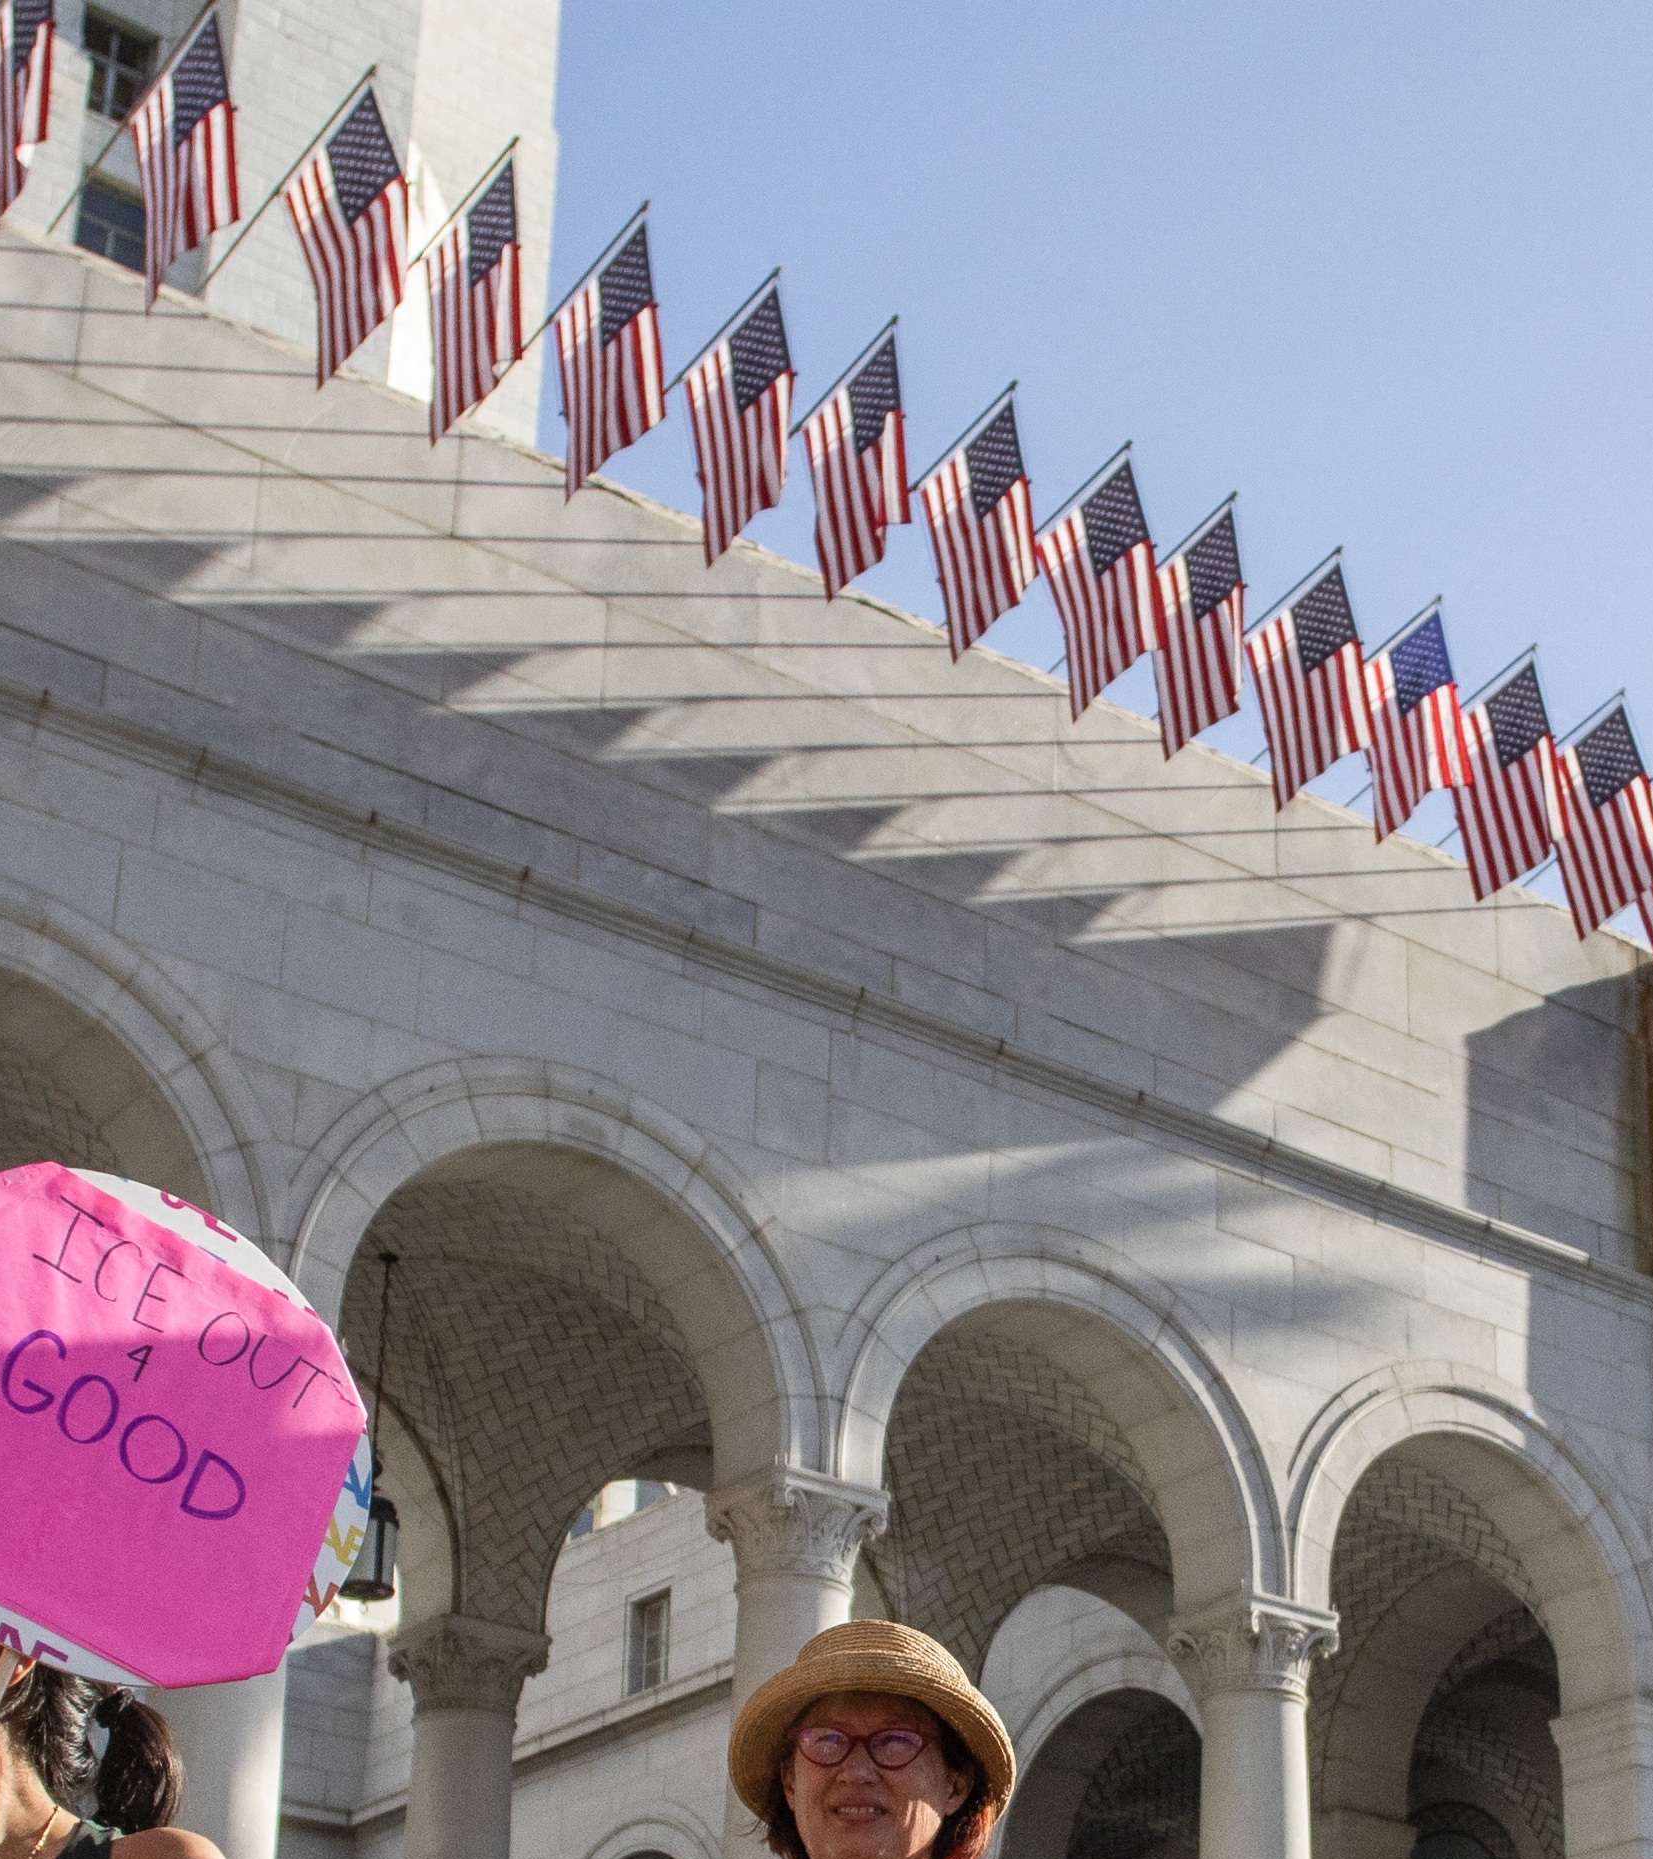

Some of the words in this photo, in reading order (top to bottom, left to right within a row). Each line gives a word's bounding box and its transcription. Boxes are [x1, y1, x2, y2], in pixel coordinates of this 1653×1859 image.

[32, 1194, 184, 1334] ICE
[197, 1311, 342, 1409] OUT
[125, 1345, 154, 1384] 4
[0, 1328, 247, 1522] GOOD
